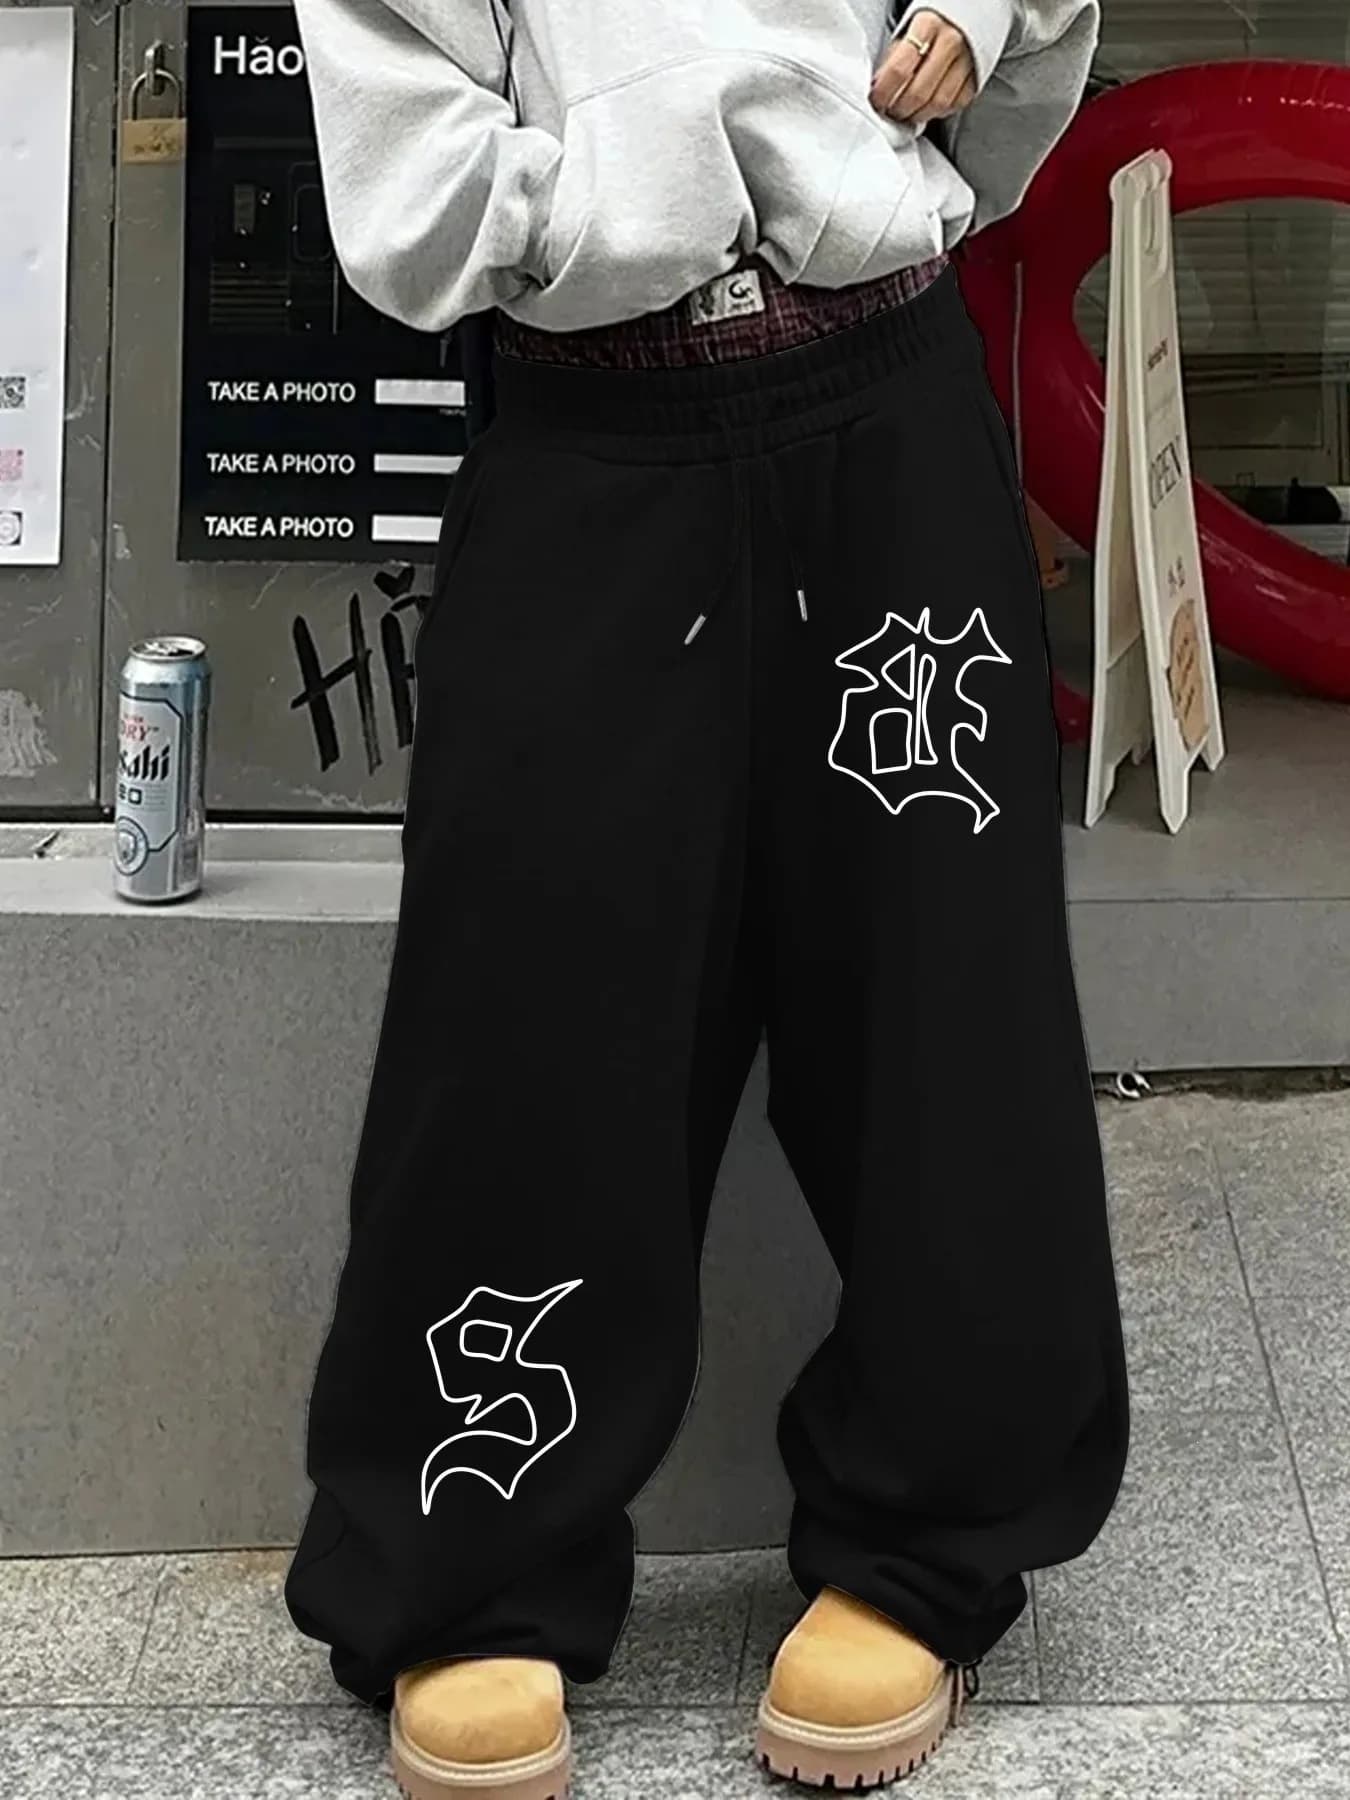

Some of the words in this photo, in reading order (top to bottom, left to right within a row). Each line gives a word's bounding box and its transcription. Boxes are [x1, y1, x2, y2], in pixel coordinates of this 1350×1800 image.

[207, 381, 260, 402] TAKE
[263, 381, 279, 402] A
[282, 381, 356, 403] PHOTO
[206, 453, 259, 474] TAKE
[262, 453, 278, 474] A
[281, 453, 356, 475] PHOTO
[204, 515, 258, 537] TAKE
[260, 515, 277, 537] A
[279, 515, 354, 538] PHOTO
[421, 1278, 583, 1516] S
